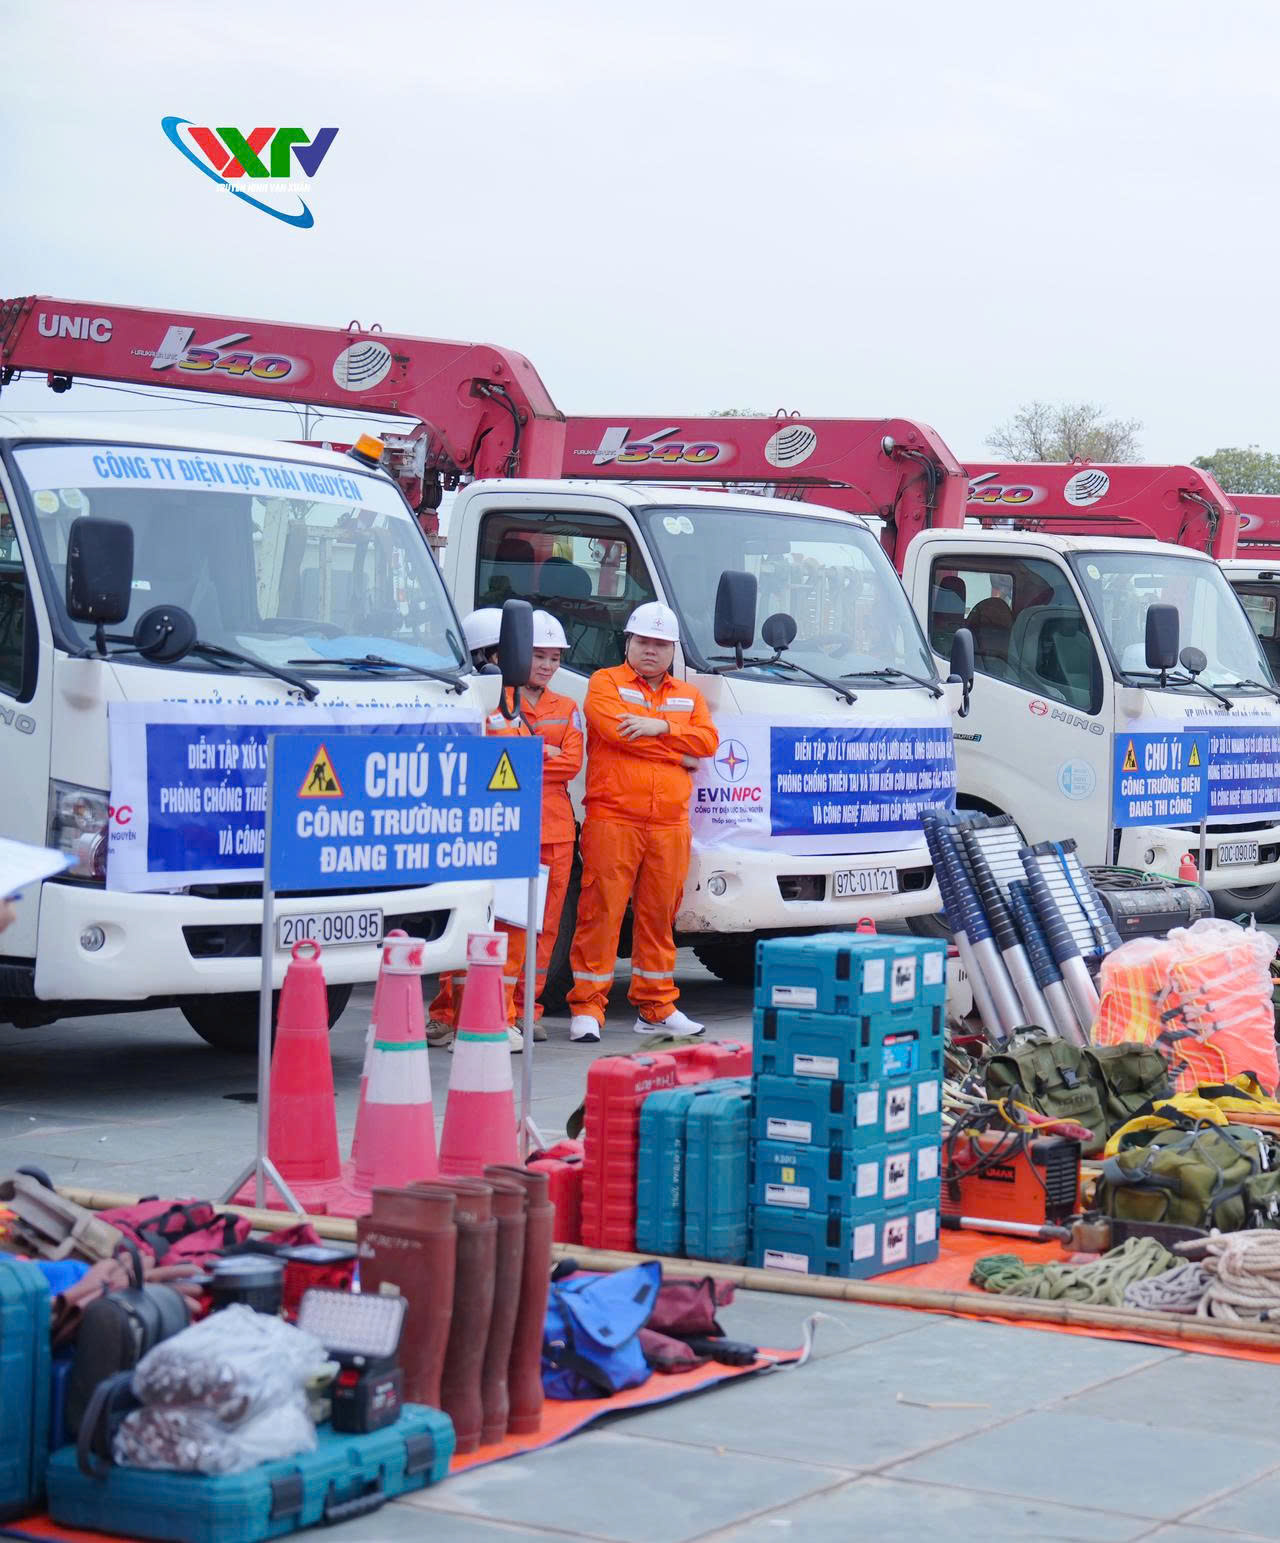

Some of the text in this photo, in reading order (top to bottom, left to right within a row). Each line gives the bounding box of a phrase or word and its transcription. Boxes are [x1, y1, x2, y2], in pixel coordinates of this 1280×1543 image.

[38, 313, 113, 343] UNIC
[93, 450, 364, 501] CÔNG TY ĐIỆN LỰC THÁI NGUYÊN
[1051, 709, 1105, 735] HINO
[188, 735, 216, 769] DIỄN
[218, 739, 240, 775] TẬP
[794, 736, 812, 761] DIỄN
[813, 739, 826, 765] TẬP
[838, 739, 847, 761] LÝ
[1144, 737, 1168, 772] CHÚ
[365, 743, 468, 798] CHÚ Ý!
[777, 771, 802, 793] PHÒNG
[803, 768, 827, 793] CHỐNG
[828, 770, 848, 792] THIÊN
[1121, 774, 1201, 796] CÔNG TRƯỜNG ĐIỆN
[160, 781, 201, 813] PHÒNG
[203, 778, 243, 812] CHỐNG
[697, 787, 762, 802] EVNNPC
[1129, 795, 1193, 818] ĐANG THI CÔNG
[297, 802, 521, 838] CÔNG TRƯỜNG ĐIỆN
[813, 801, 822, 824] VÀ
[823, 802, 842, 824] CÔNG
[219, 825, 265, 855] VÀ CÔNG
[320, 837, 498, 873] ĐANG THI CÔNG
